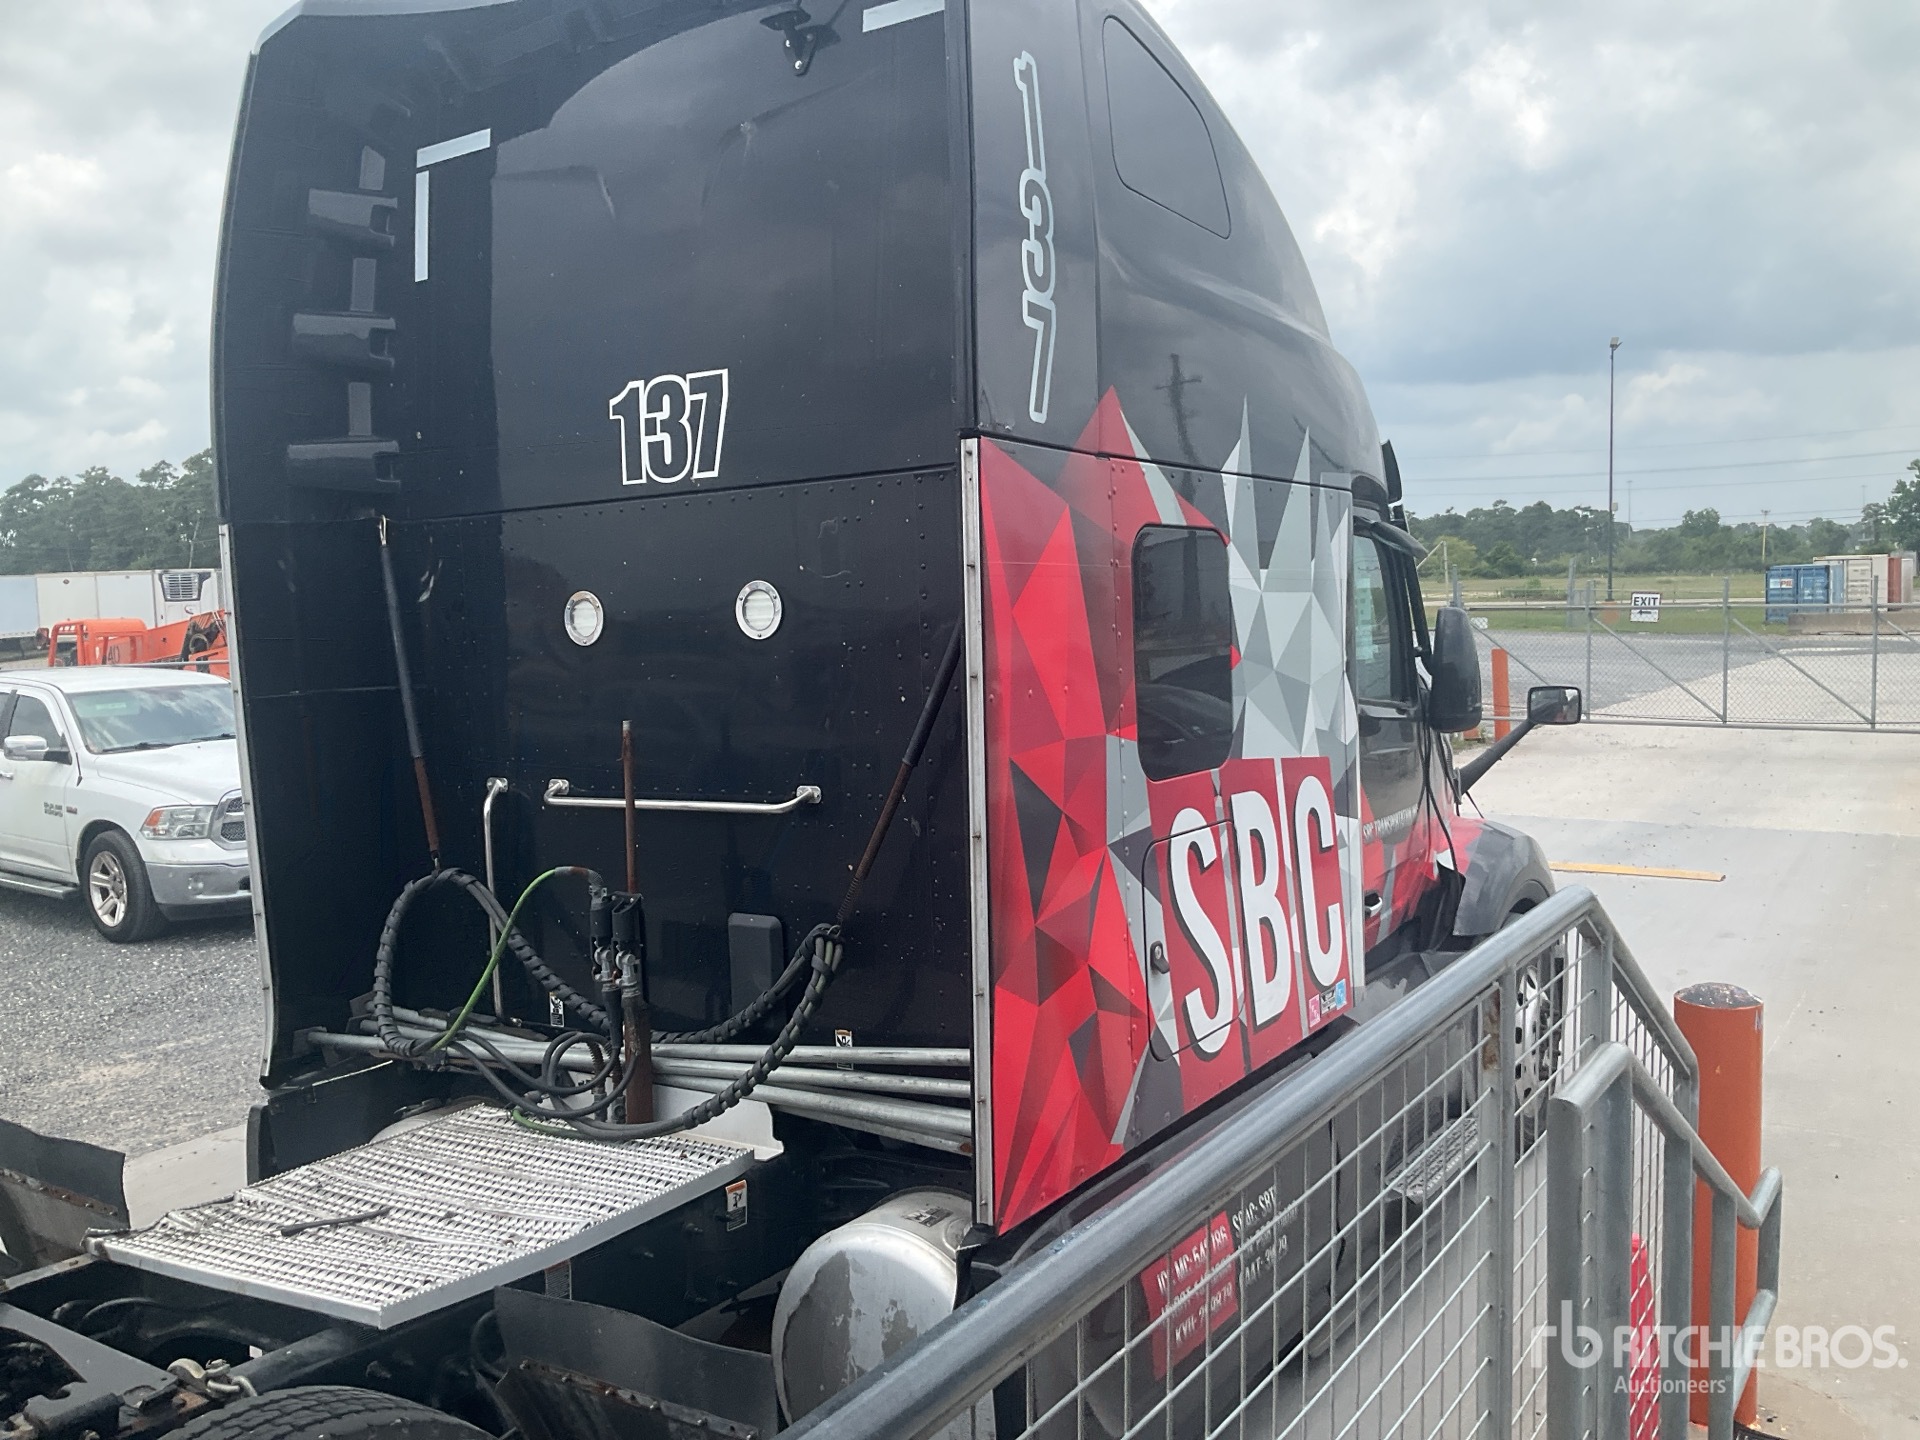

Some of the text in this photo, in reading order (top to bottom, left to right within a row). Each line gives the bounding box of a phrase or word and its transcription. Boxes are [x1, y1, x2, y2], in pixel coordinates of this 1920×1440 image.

[1013, 50, 1056, 423] 137
[609, 369, 729, 485] 137
[1633, 597, 1659, 606] EXIT
[1169, 775, 1344, 1055] SBC
